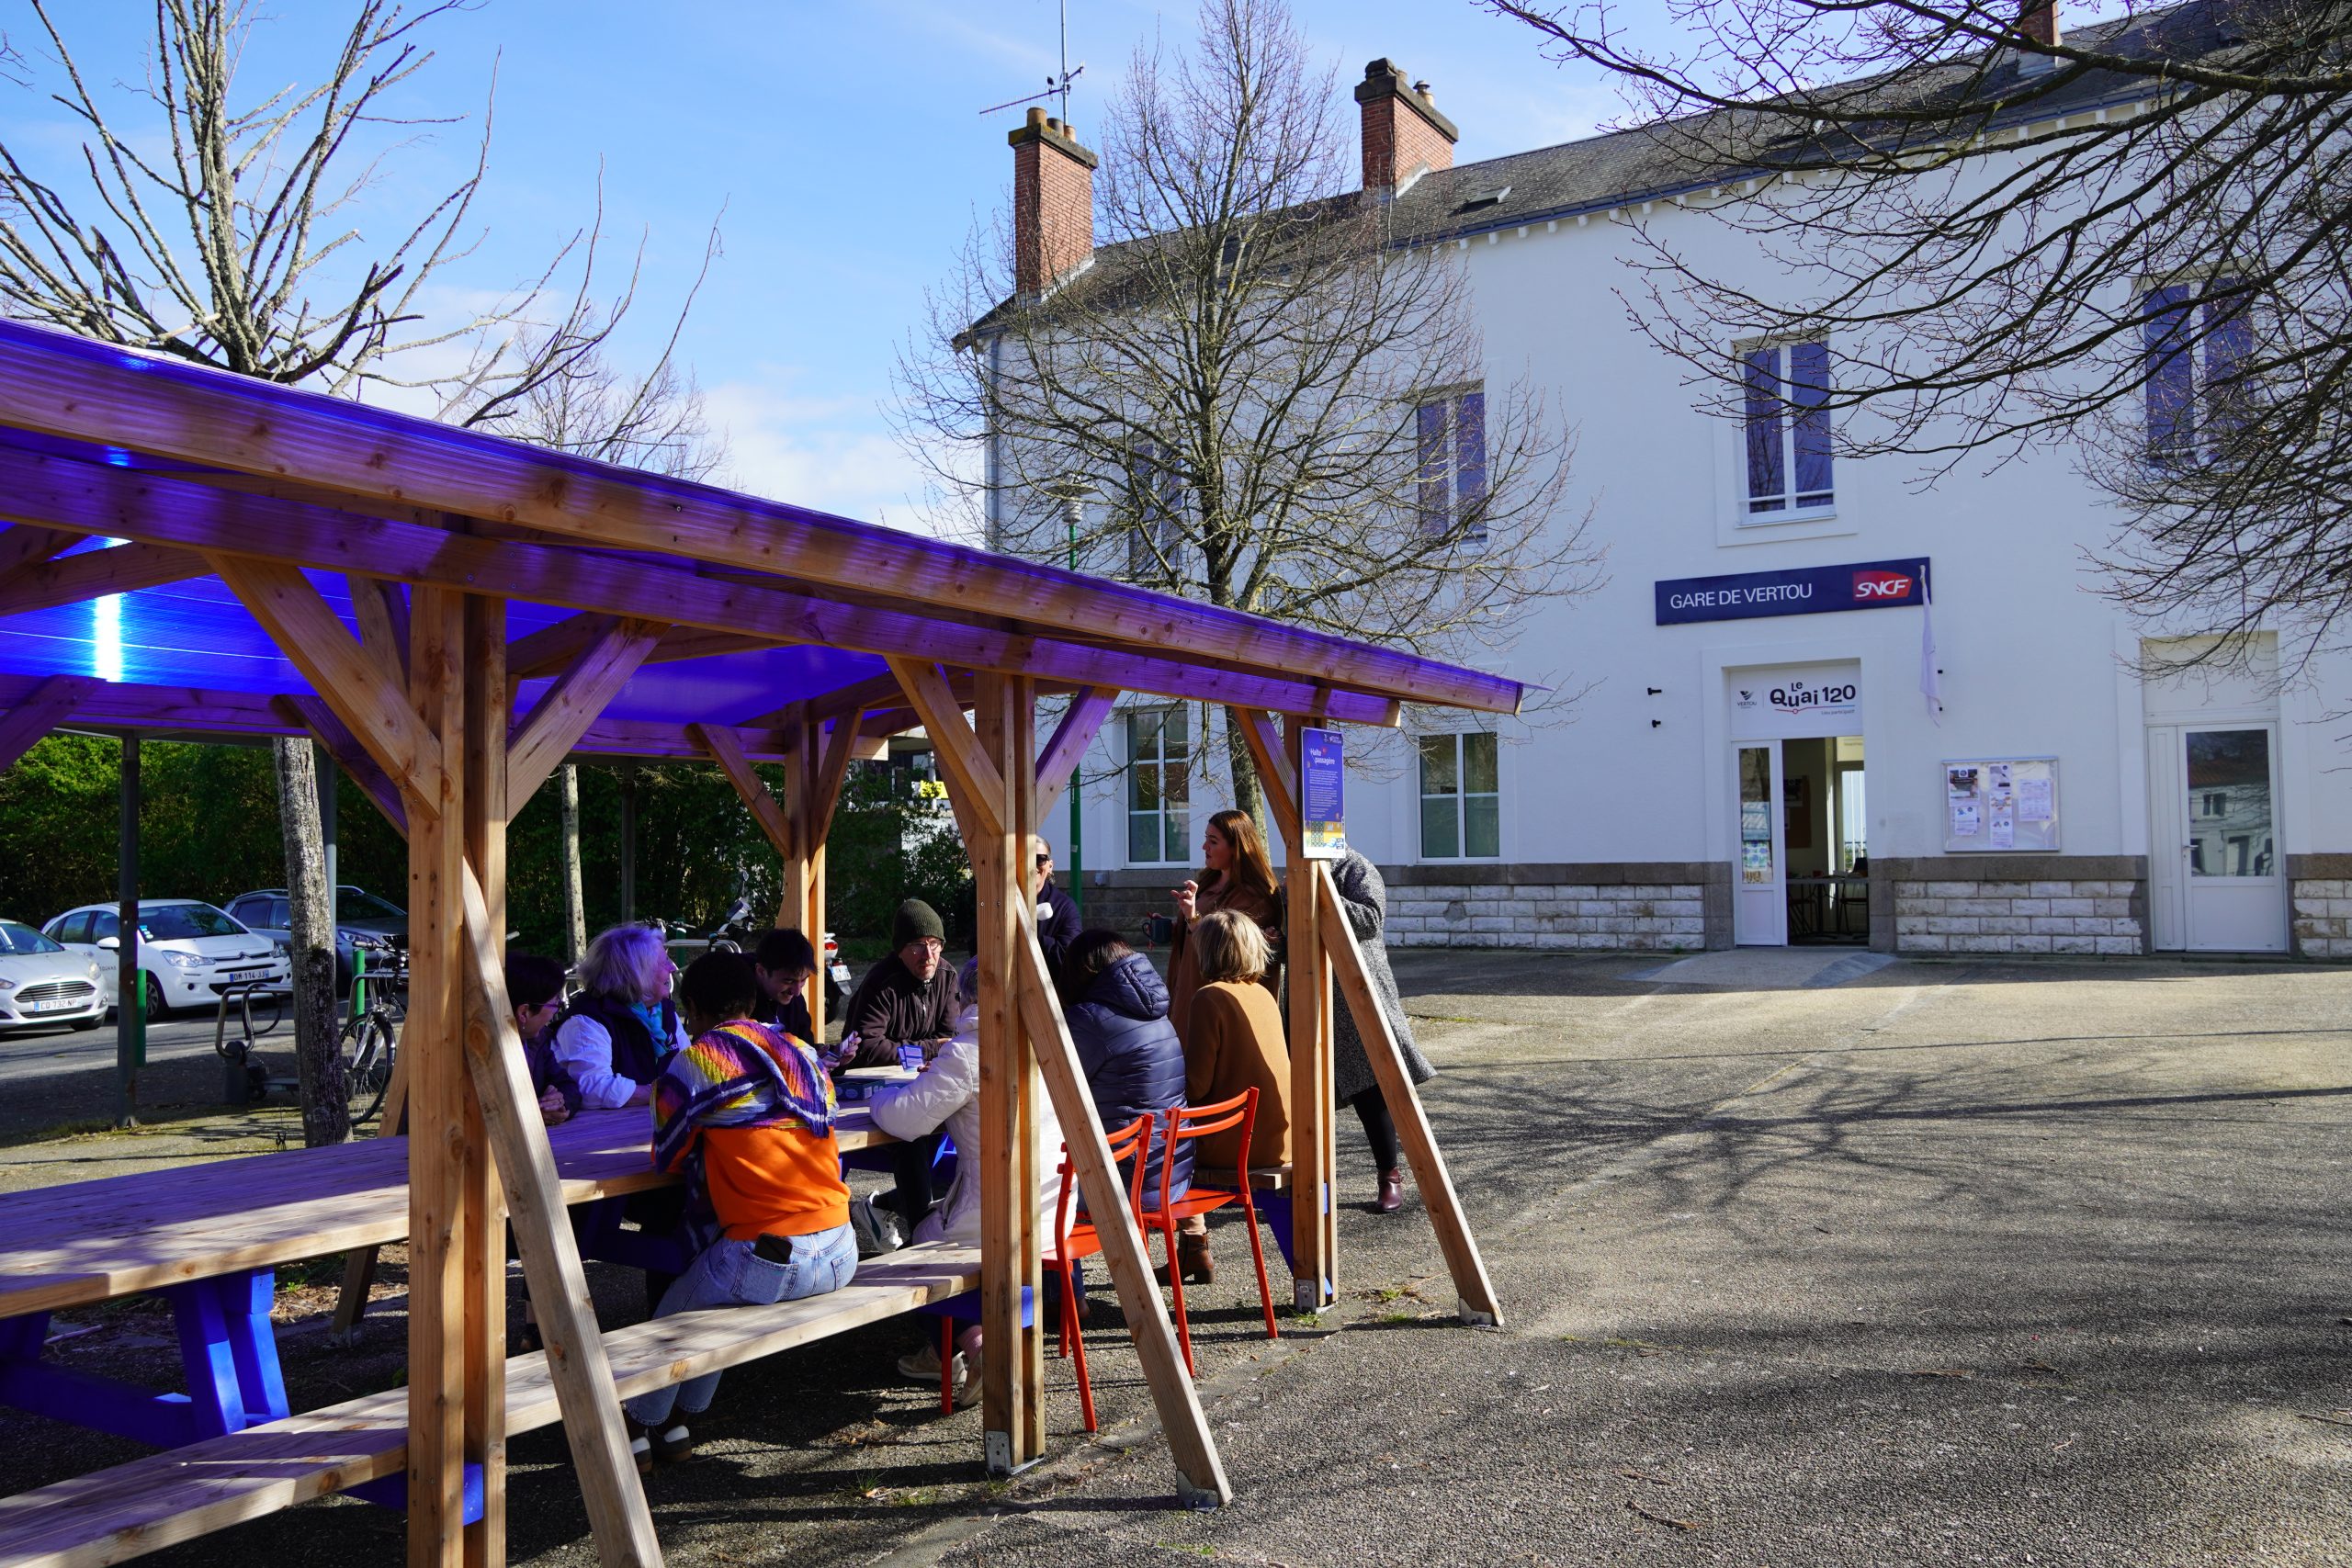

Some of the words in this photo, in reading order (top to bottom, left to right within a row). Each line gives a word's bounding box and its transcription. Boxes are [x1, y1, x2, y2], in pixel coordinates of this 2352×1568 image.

[1855, 579, 1909, 597] SNCF
[1670, 592, 1715, 609] GARE
[1719, 589, 1741, 605] DE
[1743, 582, 1813, 603] VERTOU
[1791, 682, 1803, 692] Le
[1770, 688, 1818, 707] Quai
[1822, 684, 1856, 703] 120
[1308, 748, 1322, 757] Halte
[1314, 757, 1335, 766] passagère
